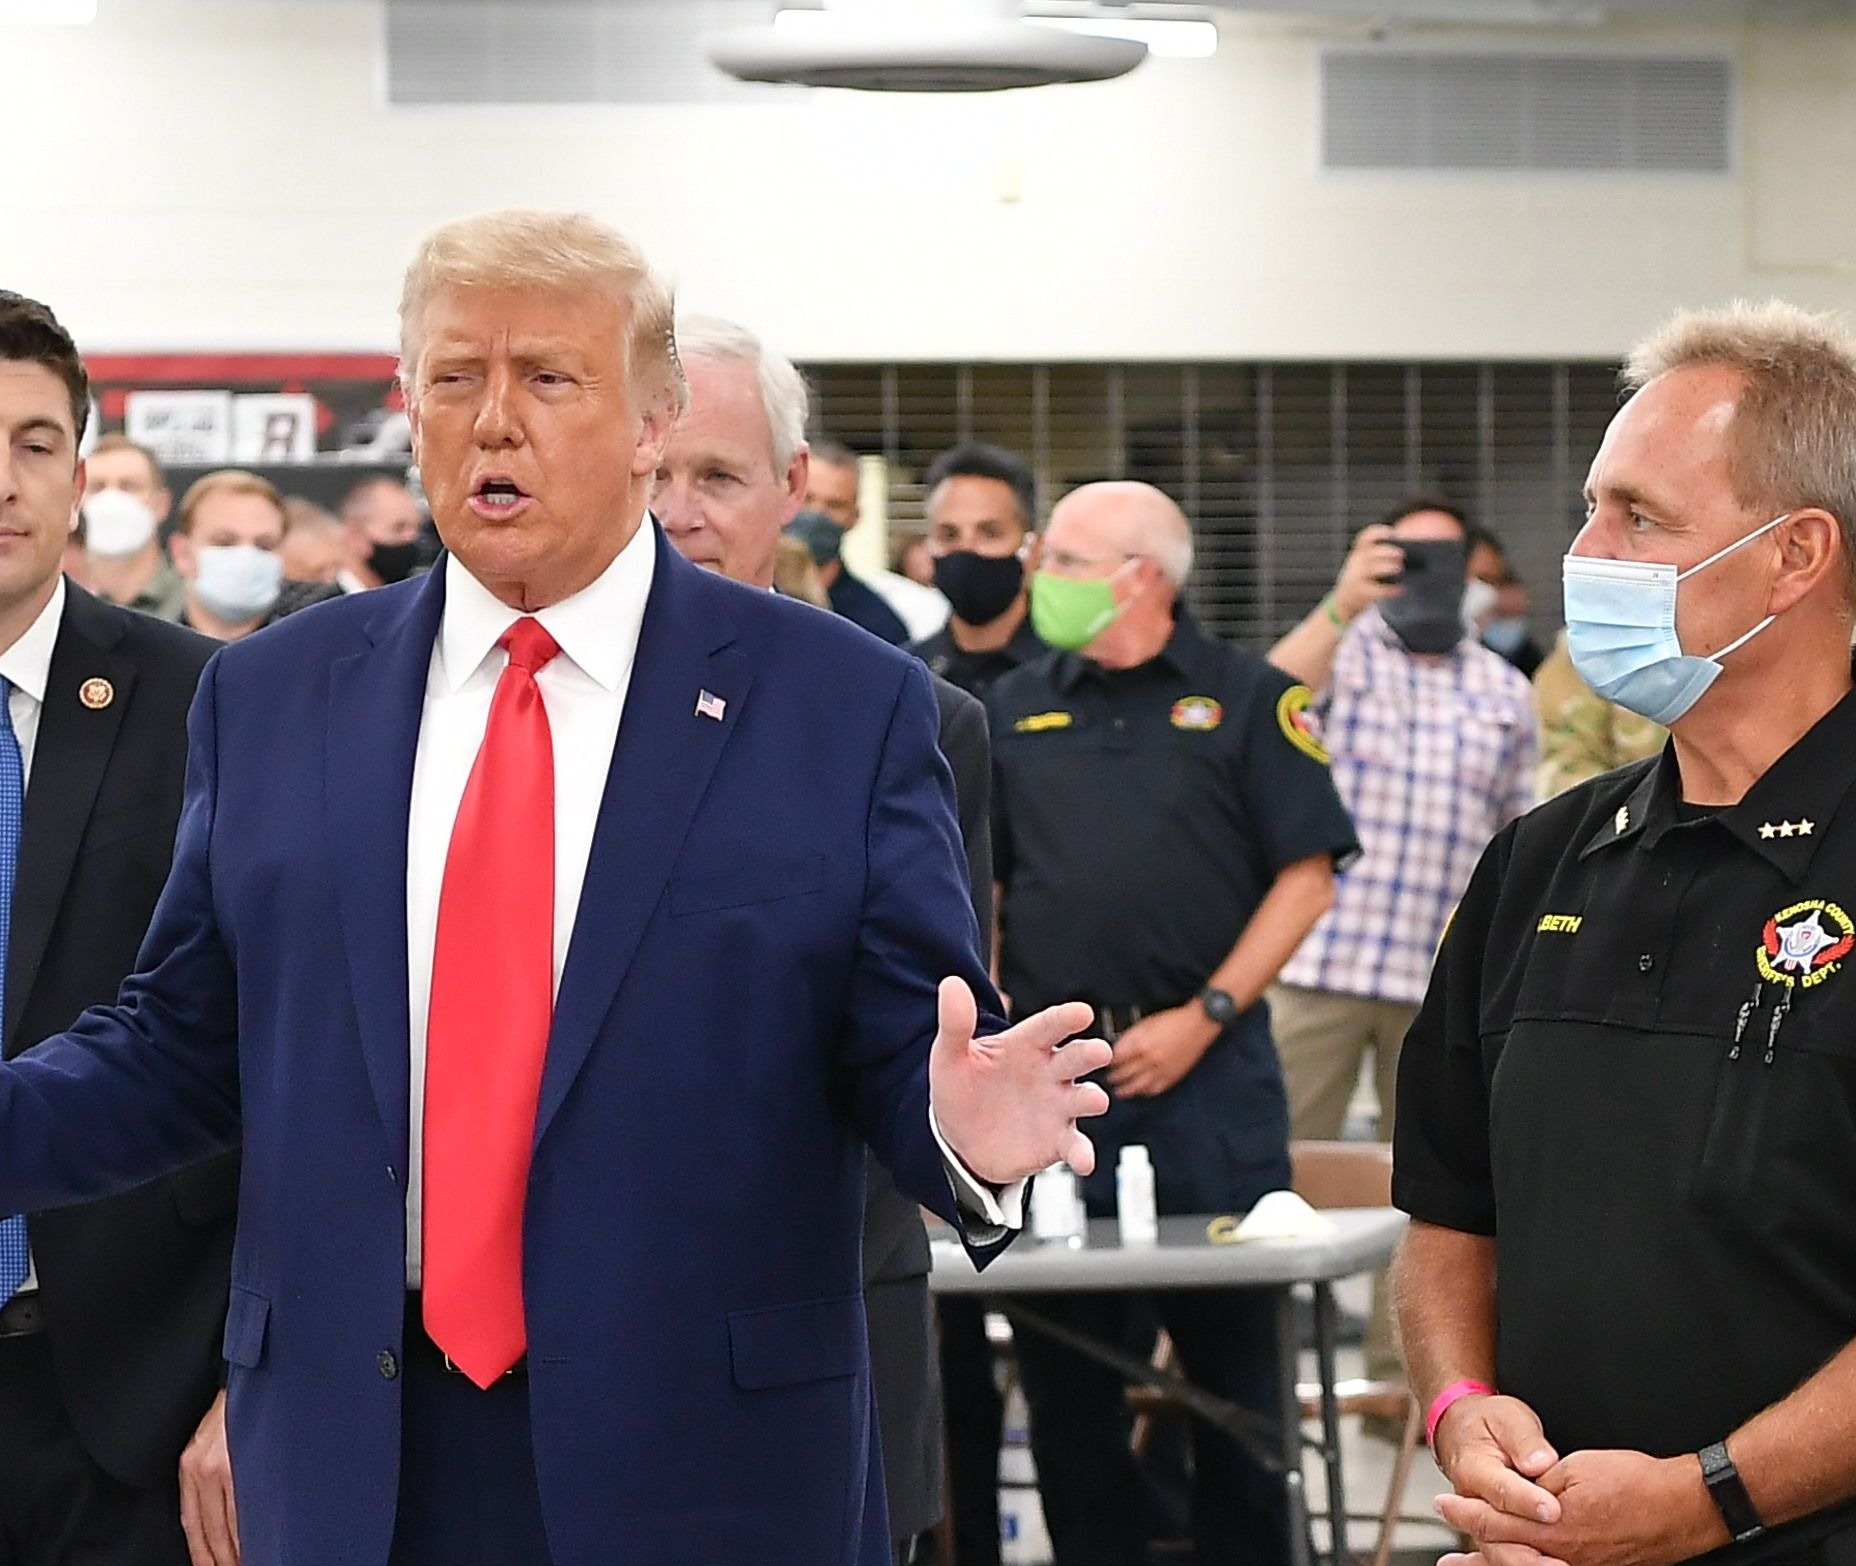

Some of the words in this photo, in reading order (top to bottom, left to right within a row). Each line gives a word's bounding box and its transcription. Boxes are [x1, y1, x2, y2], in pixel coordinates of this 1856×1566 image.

[1774, 899, 1825, 923] KENOSHA
[1825, 903, 1855, 934] COUNTY
[1756, 945, 1795, 987] SHERIFF'S
[1801, 961, 1842, 988] DEPT.
